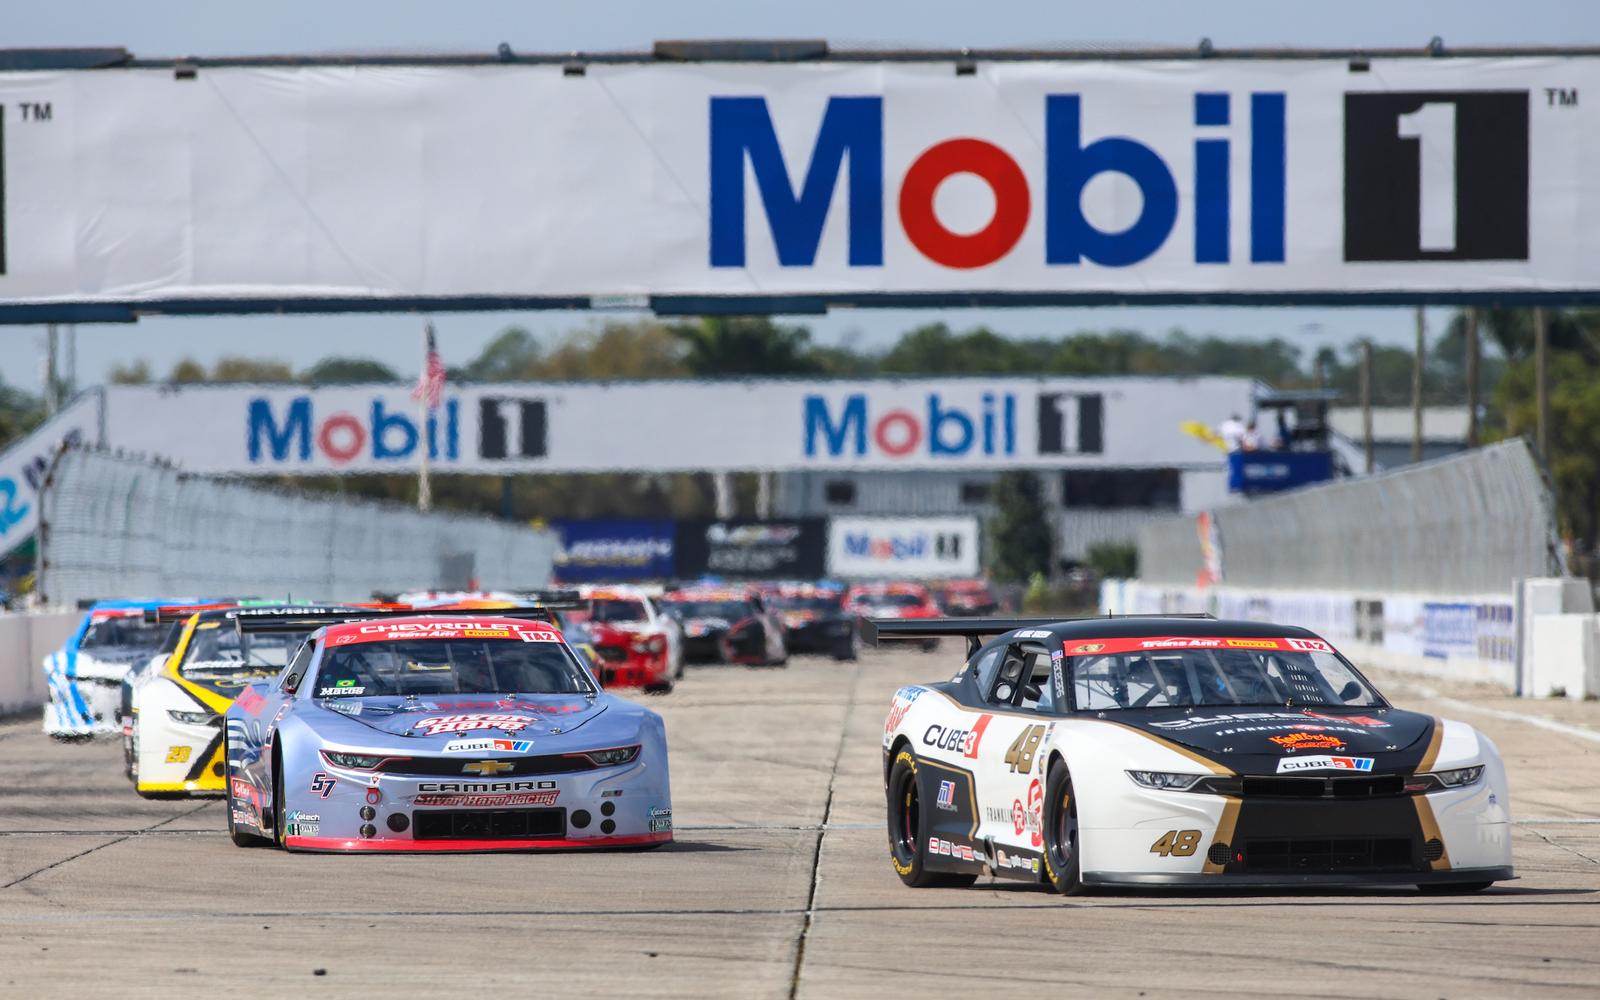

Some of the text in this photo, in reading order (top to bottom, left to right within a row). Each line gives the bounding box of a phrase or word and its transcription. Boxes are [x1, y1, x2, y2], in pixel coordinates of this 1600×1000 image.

[20, 103, 52, 121] TM
[710, 92, 1286, 269] Mobil
[1543, 87, 1578, 106] TM
[248, 396, 458, 463] Mobil
[804, 393, 1016, 457] Mobil
[360, 622, 524, 634] CHEVROLET
[522, 632, 555, 641] TA2
[1295, 640, 1328, 650] TA2
[320, 686, 365, 696] Matos
[1004, 724, 1046, 774] 48
[310, 772, 337, 800] 57
[418, 780, 558, 793] CAMARO
[506, 790, 560, 807] Racing
[1150, 830, 1203, 857] 48
